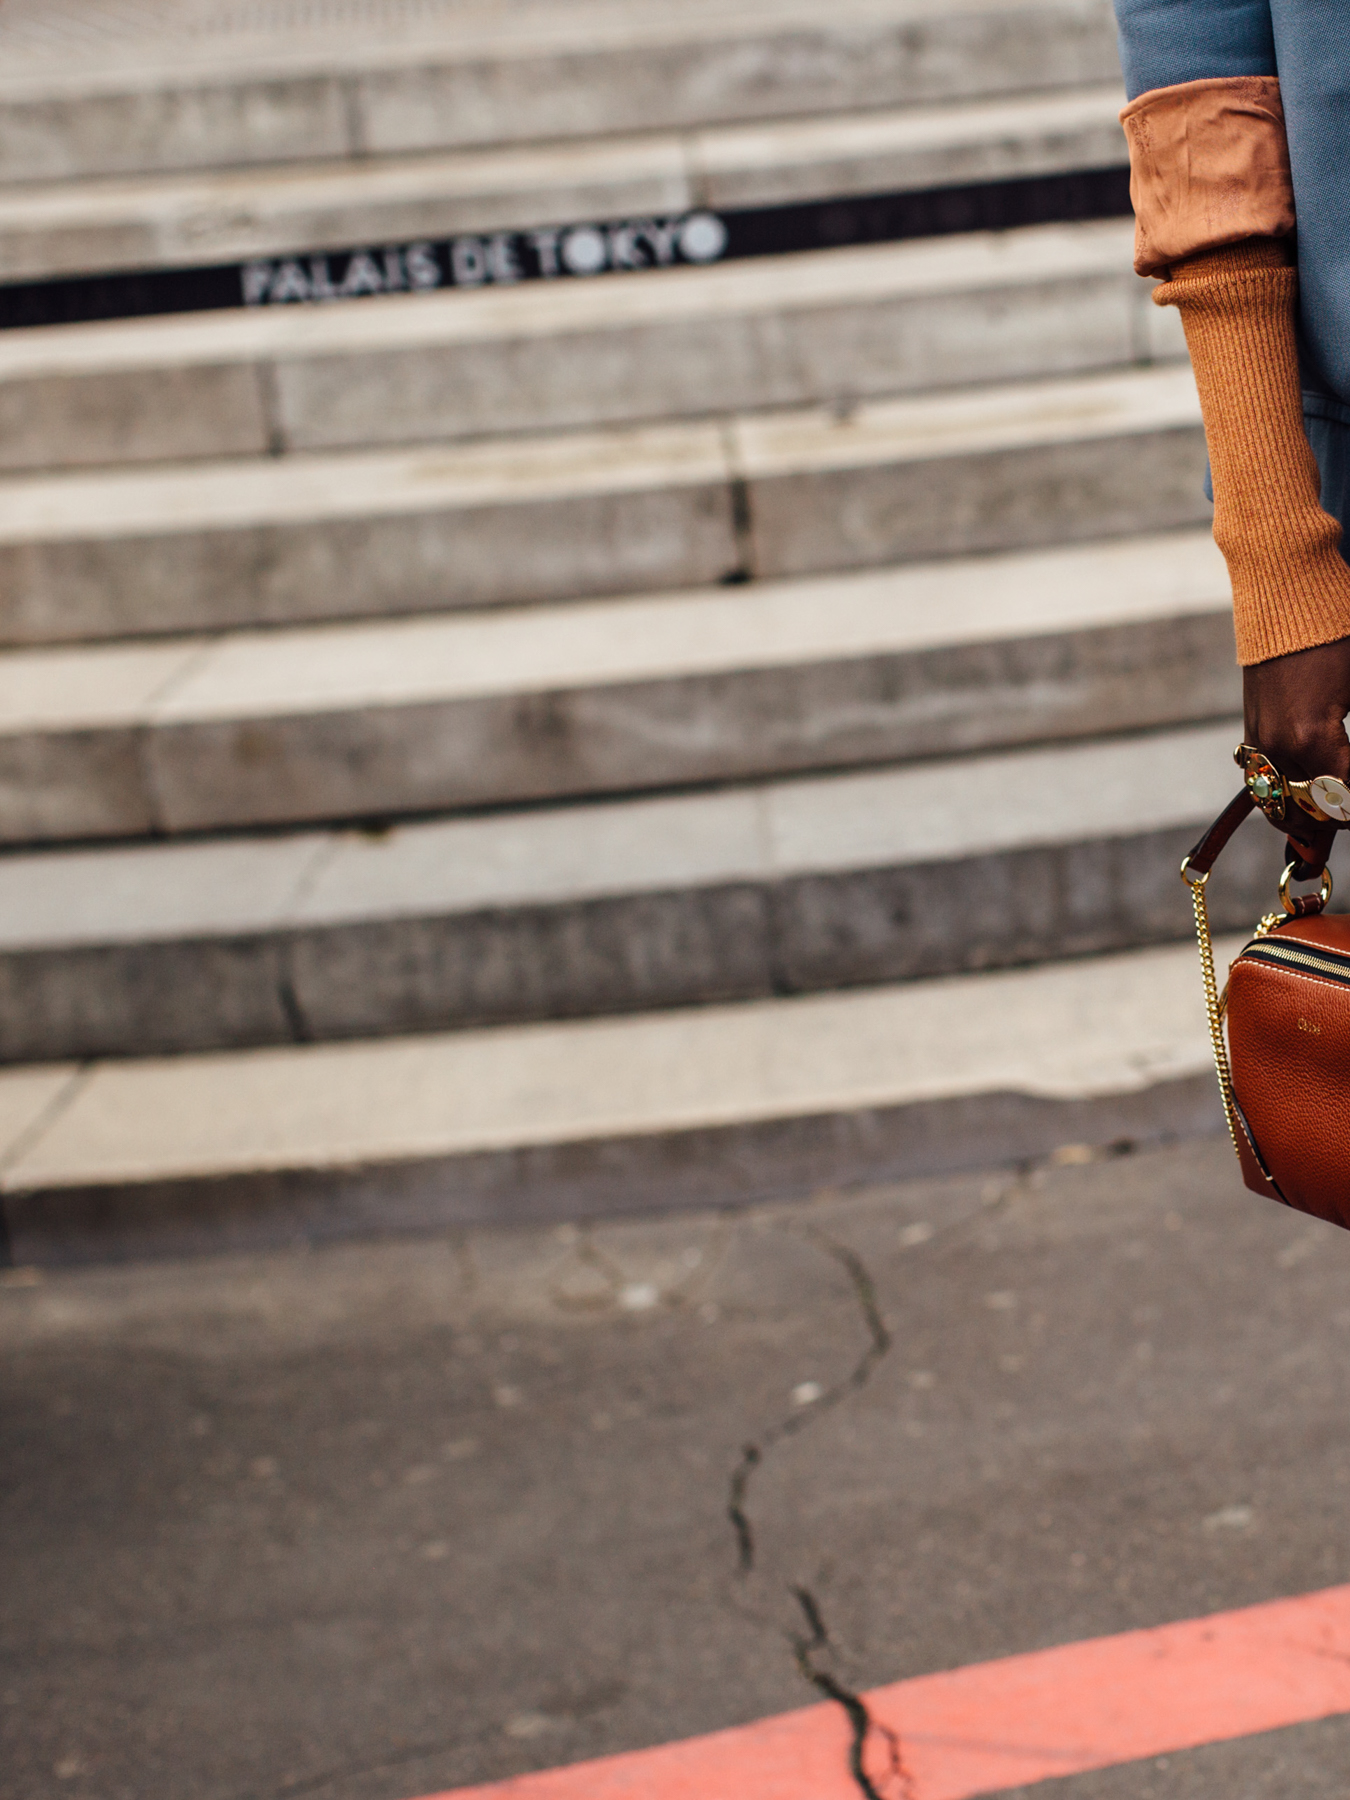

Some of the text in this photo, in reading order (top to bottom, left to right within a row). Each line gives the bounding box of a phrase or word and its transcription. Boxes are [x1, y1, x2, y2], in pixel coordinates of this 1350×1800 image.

[241, 213, 727, 305] PALAIS DE TOKYO
